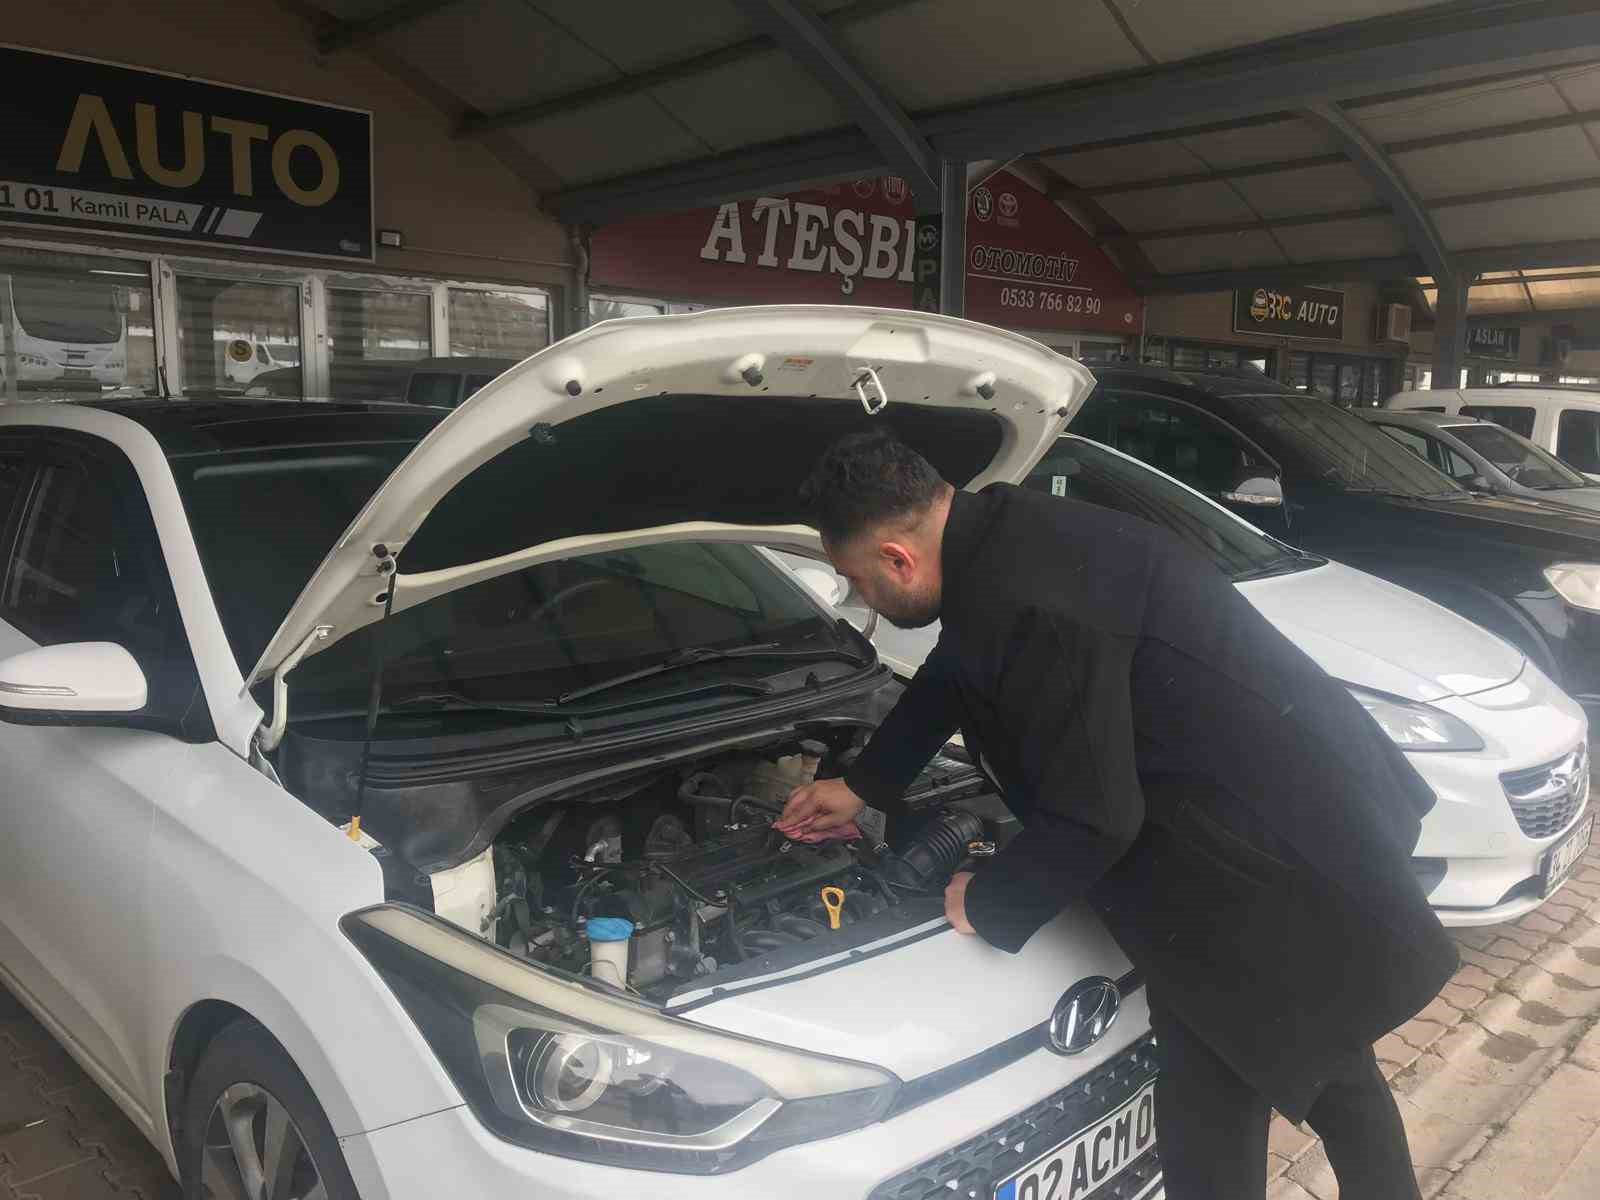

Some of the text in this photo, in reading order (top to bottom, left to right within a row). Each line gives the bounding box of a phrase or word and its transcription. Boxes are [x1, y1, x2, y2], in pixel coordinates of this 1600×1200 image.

[55, 93, 341, 208] AUTO
[23, 187, 59, 213] 01
[70, 196, 130, 219] Kamil
[135, 203, 189, 225] PALA
[970, 244, 1080, 283] OTOMOTİV
[1000, 287, 1101, 314] 0533 766 82 90
[1296, 300, 1339, 325] AUTO
